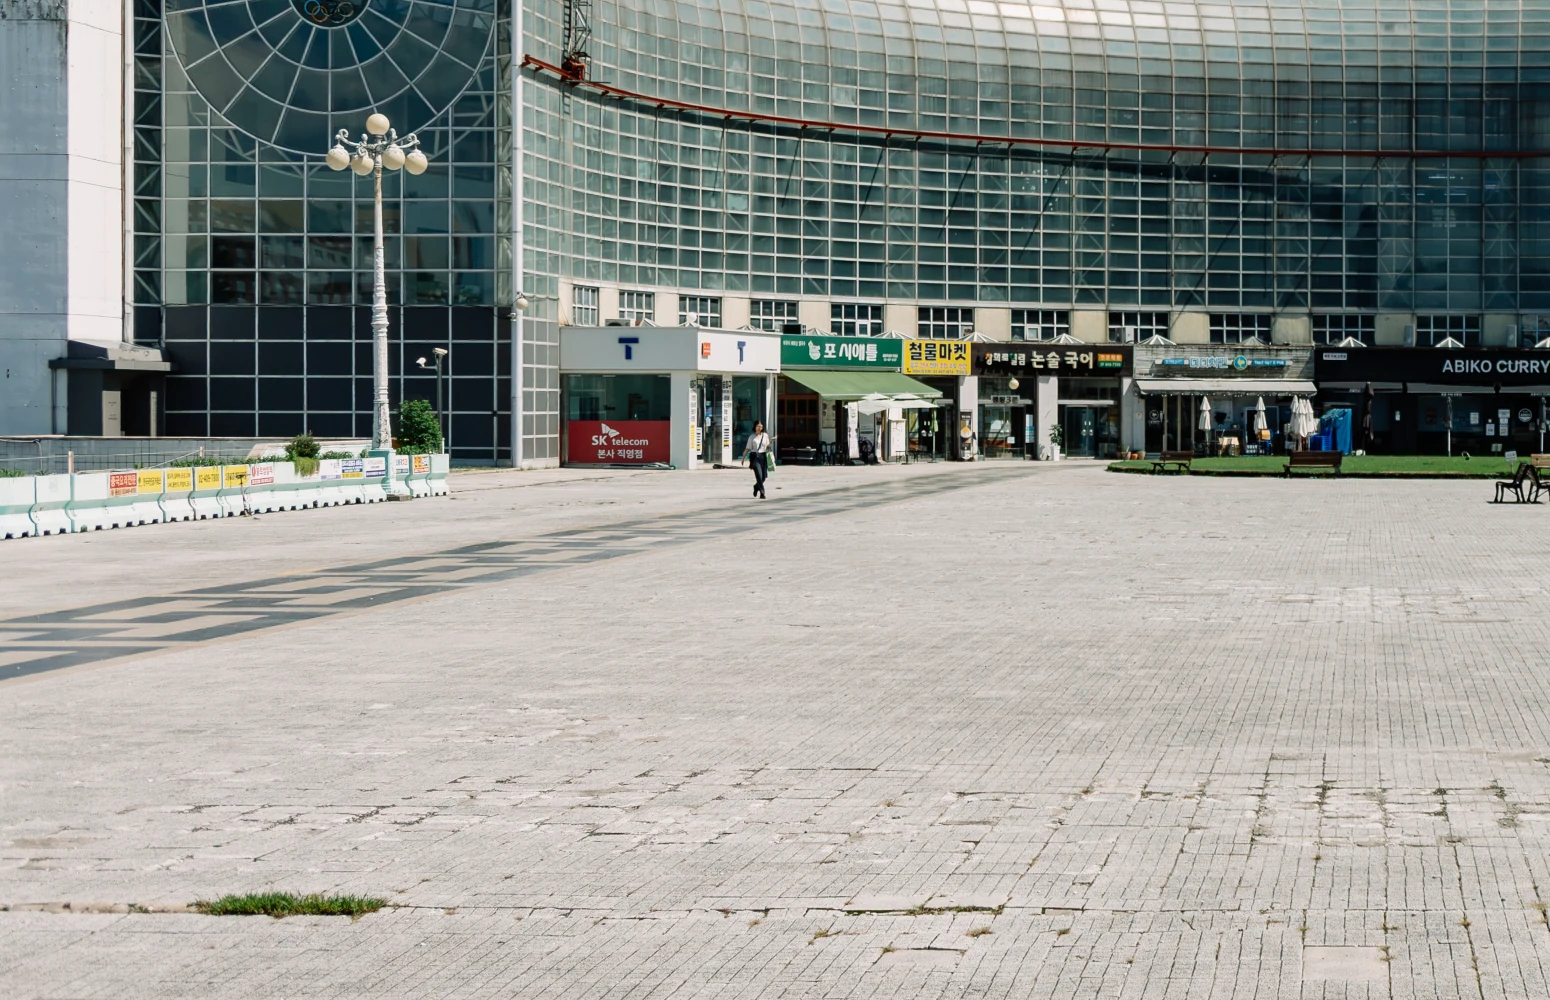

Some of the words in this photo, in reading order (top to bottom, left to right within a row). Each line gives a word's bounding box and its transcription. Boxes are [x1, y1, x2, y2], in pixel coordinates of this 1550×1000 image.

[909, 342, 967, 361] 철물마켓
[1030, 350, 1061, 369] 논술
[1063, 350, 1094, 369] 국어
[1442, 359, 1493, 374] ABIKO
[591, 434, 609, 447] SK
[611, 436, 649, 447] telecom
[597, 448, 615, 460] 본사
[617, 448, 644, 460] 직영점
